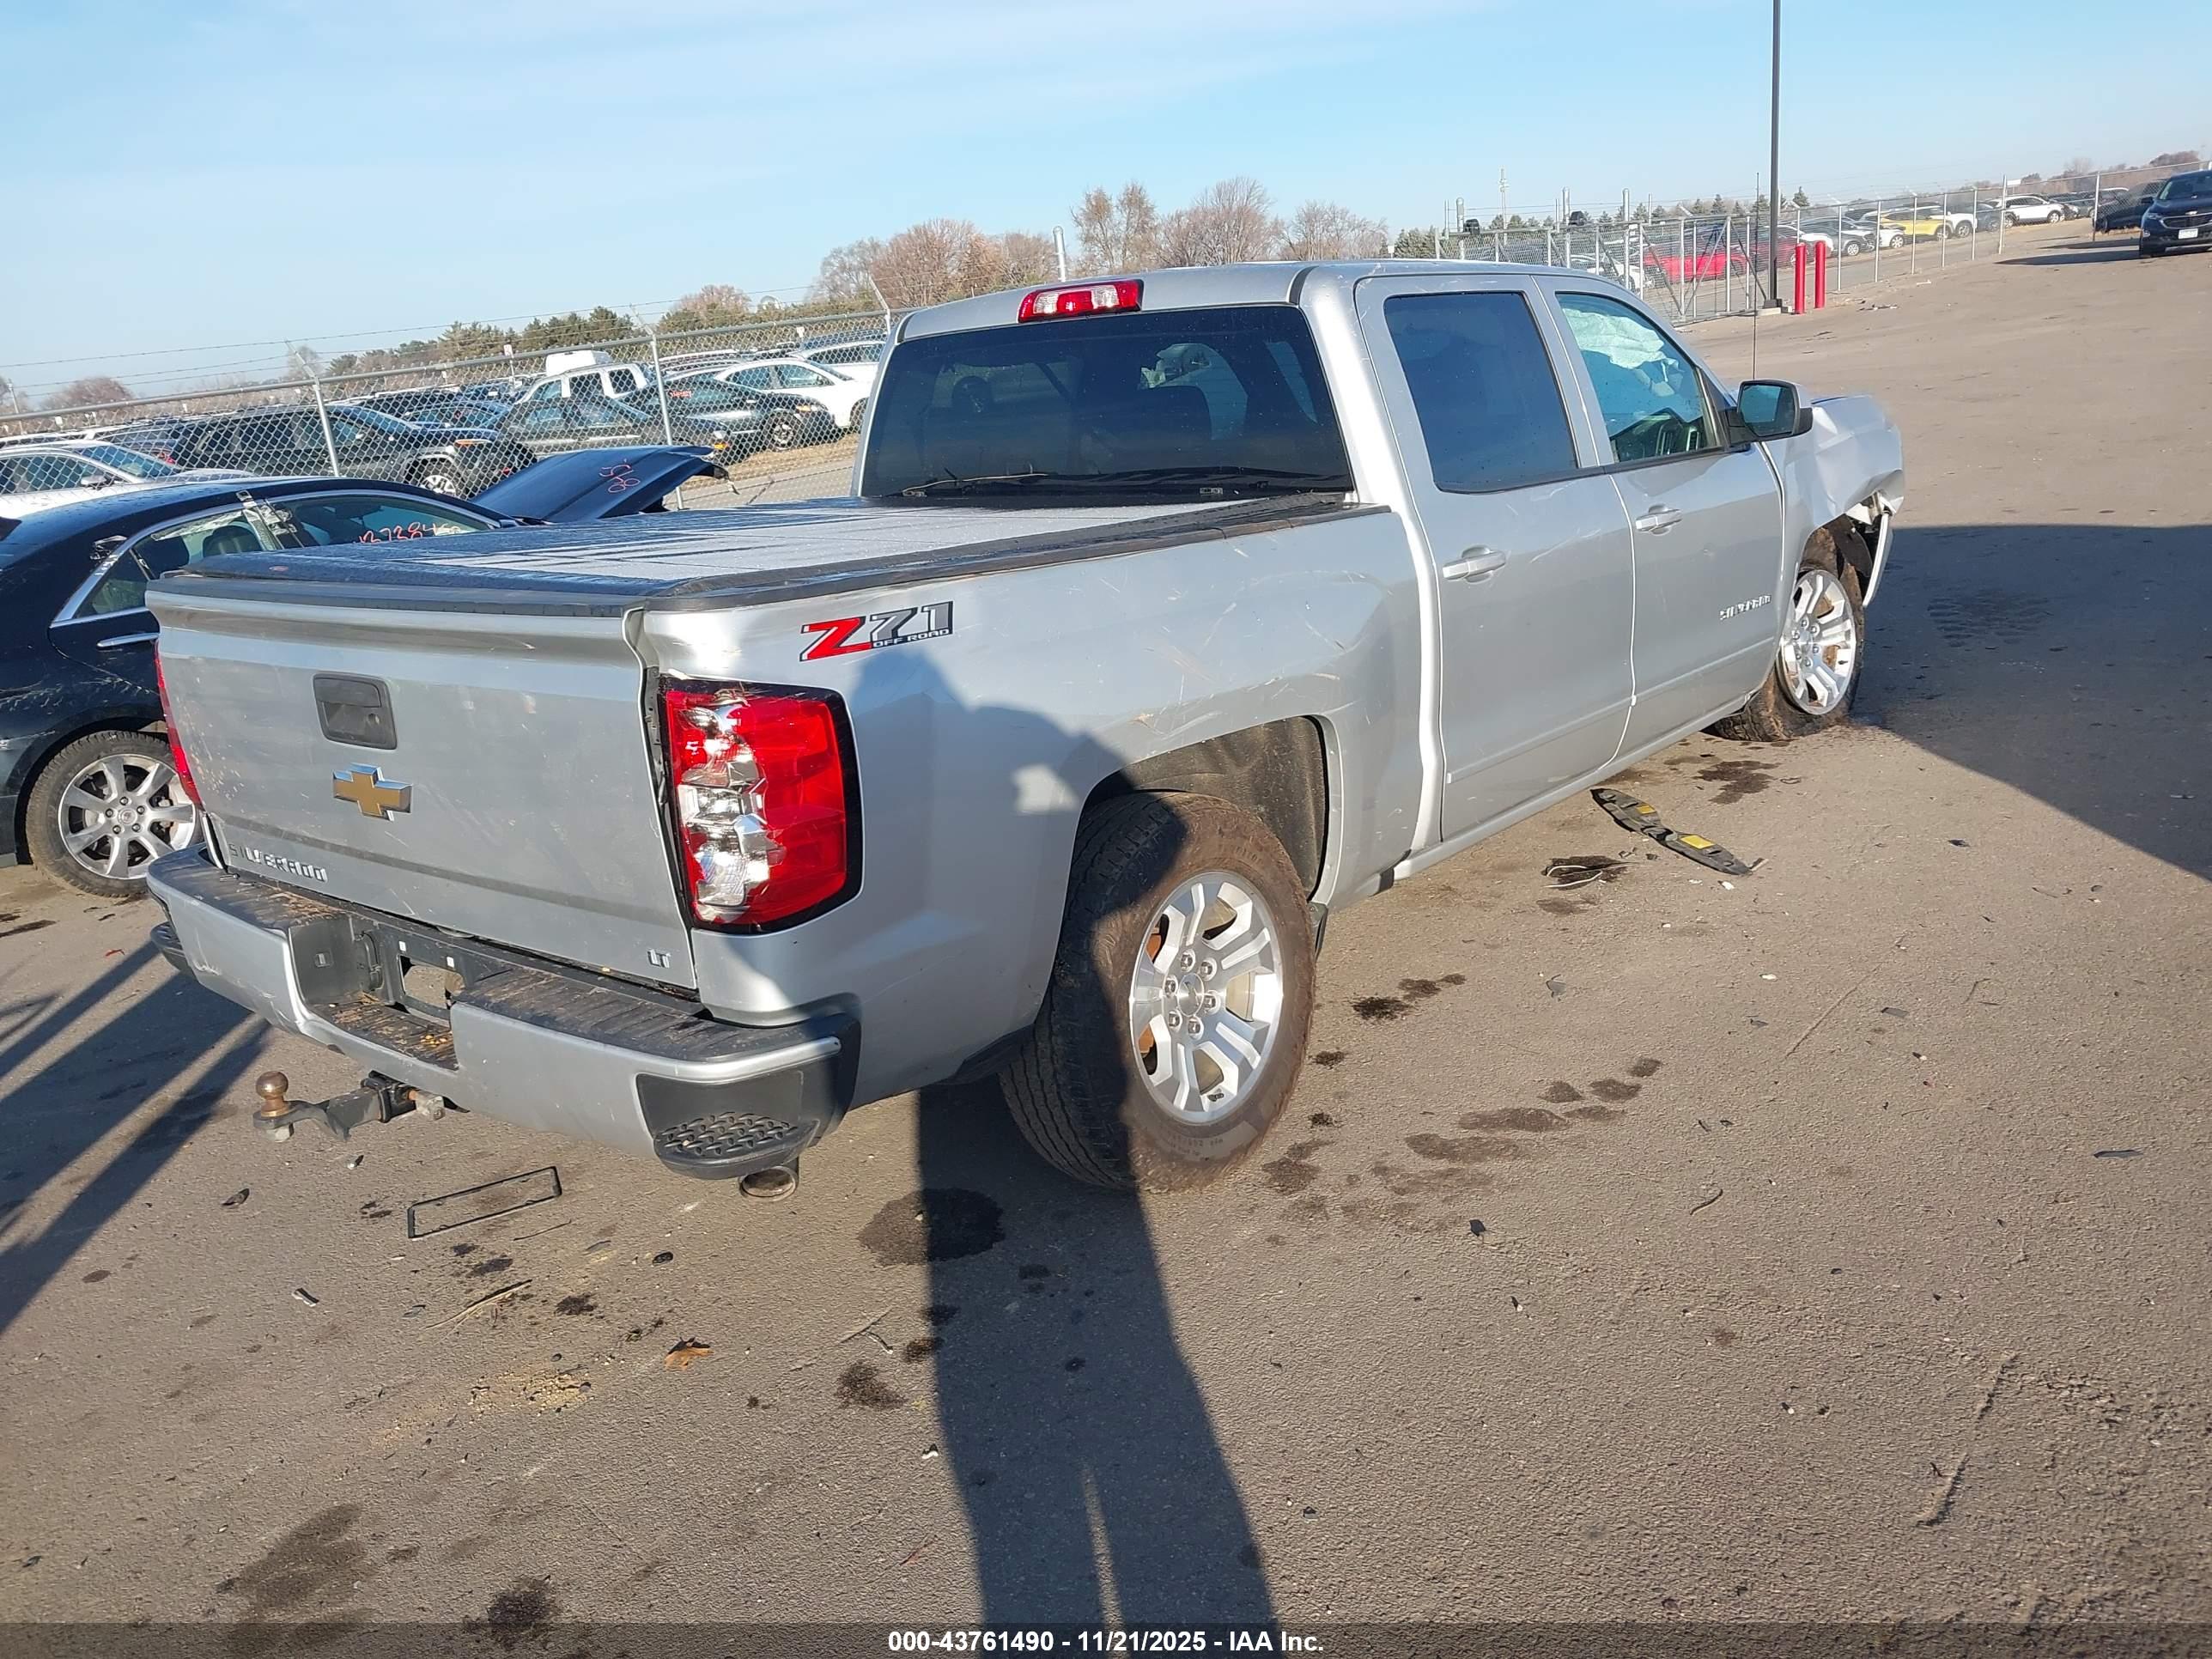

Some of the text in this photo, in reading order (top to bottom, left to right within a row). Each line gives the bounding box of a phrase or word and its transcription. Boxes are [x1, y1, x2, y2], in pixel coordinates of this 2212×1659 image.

[799, 601, 953, 662] Z71
[872, 629, 949, 647] OFF ROAD
[228, 843, 328, 883] SILVERADO
[647, 949, 671, 969] LT
